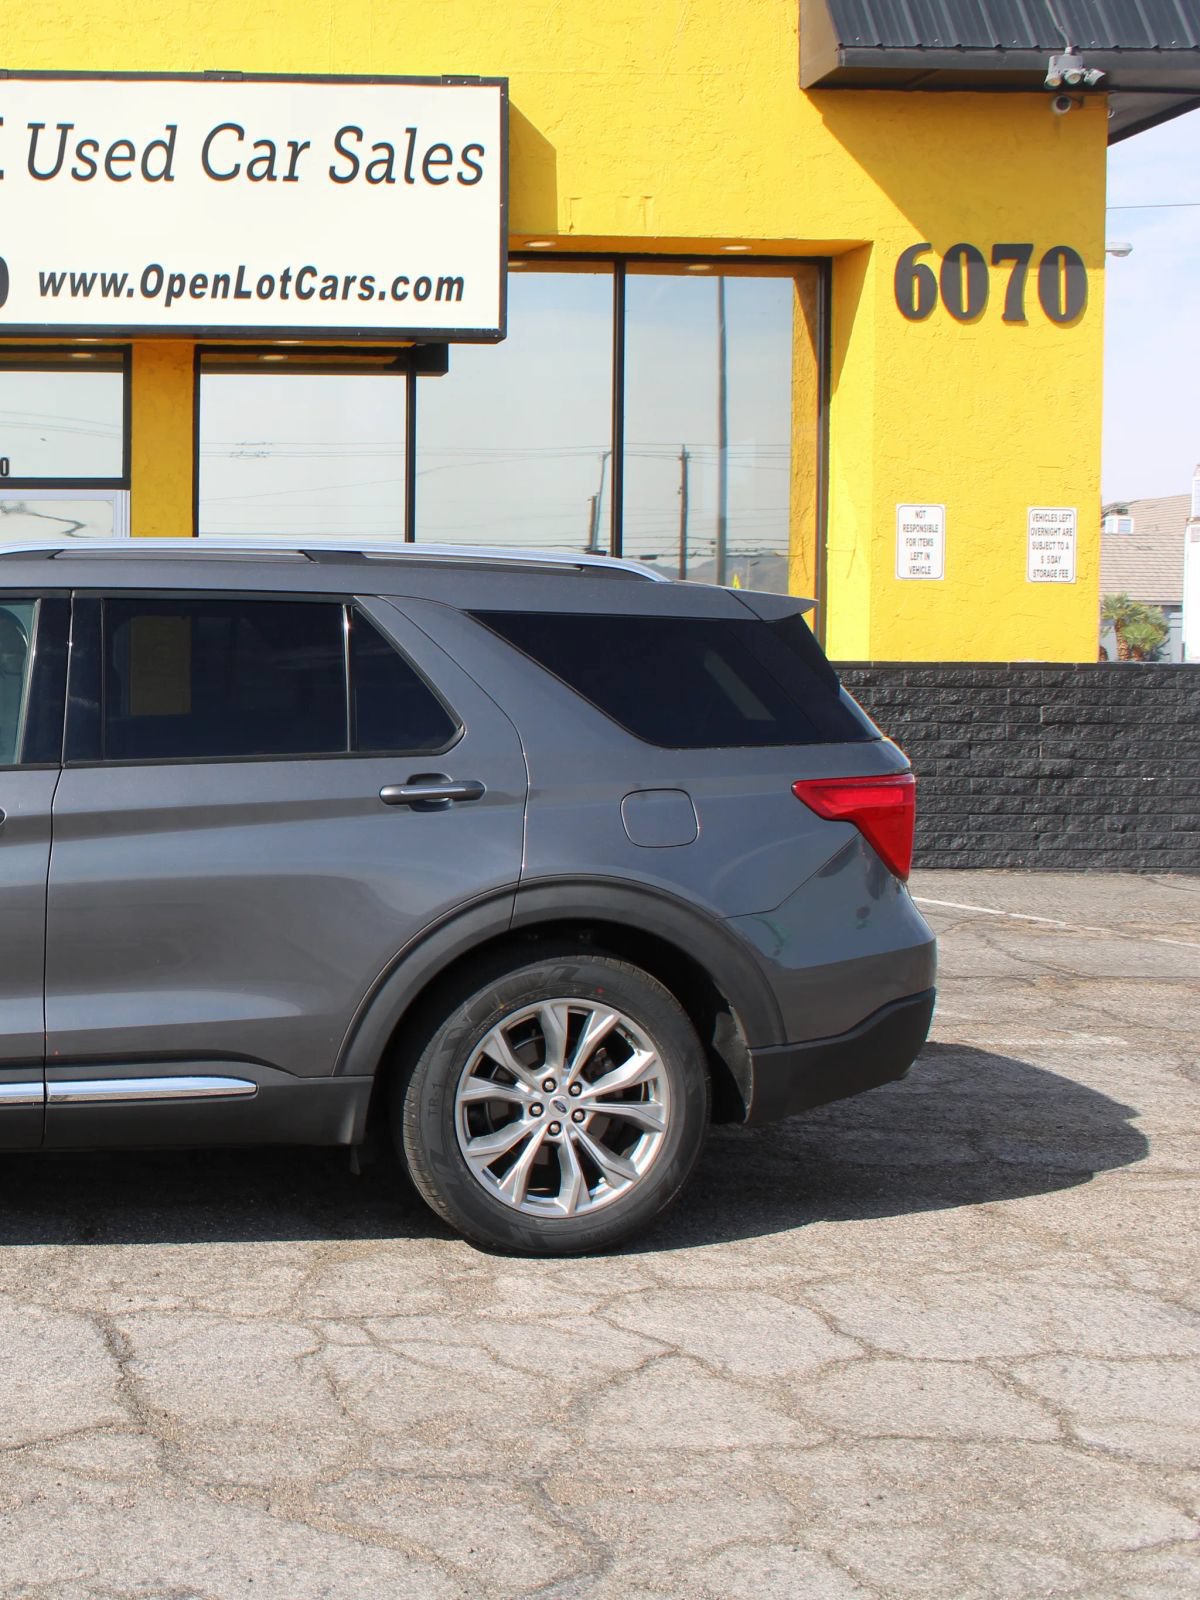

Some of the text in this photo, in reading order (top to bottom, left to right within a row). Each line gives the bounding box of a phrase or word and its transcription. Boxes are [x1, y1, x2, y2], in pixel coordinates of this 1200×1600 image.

[27, 122, 178, 183] Used
[201, 122, 311, 182] Car
[328, 125, 485, 186] Sales
[38, 263, 465, 308] www.OpenLotCars.com
[894, 242, 1089, 323] 6070
[915, 510, 926, 519] NOT
[1032, 513, 1072, 522] VEHICLES LEFT
[902, 523, 939, 533] RESPONSIBLE
[1031, 527, 1073, 537] OVERNIGHT ARE
[905, 538, 934, 547] FOR ITEMS
[1032, 541, 1056, 551] SUBJECT
[1057, 541, 1065, 551] TO
[910, 551, 931, 561] LEFT IN
[909, 565, 932, 575] VEHICLE
[1032, 569, 1069, 579] STORAGE FEE
